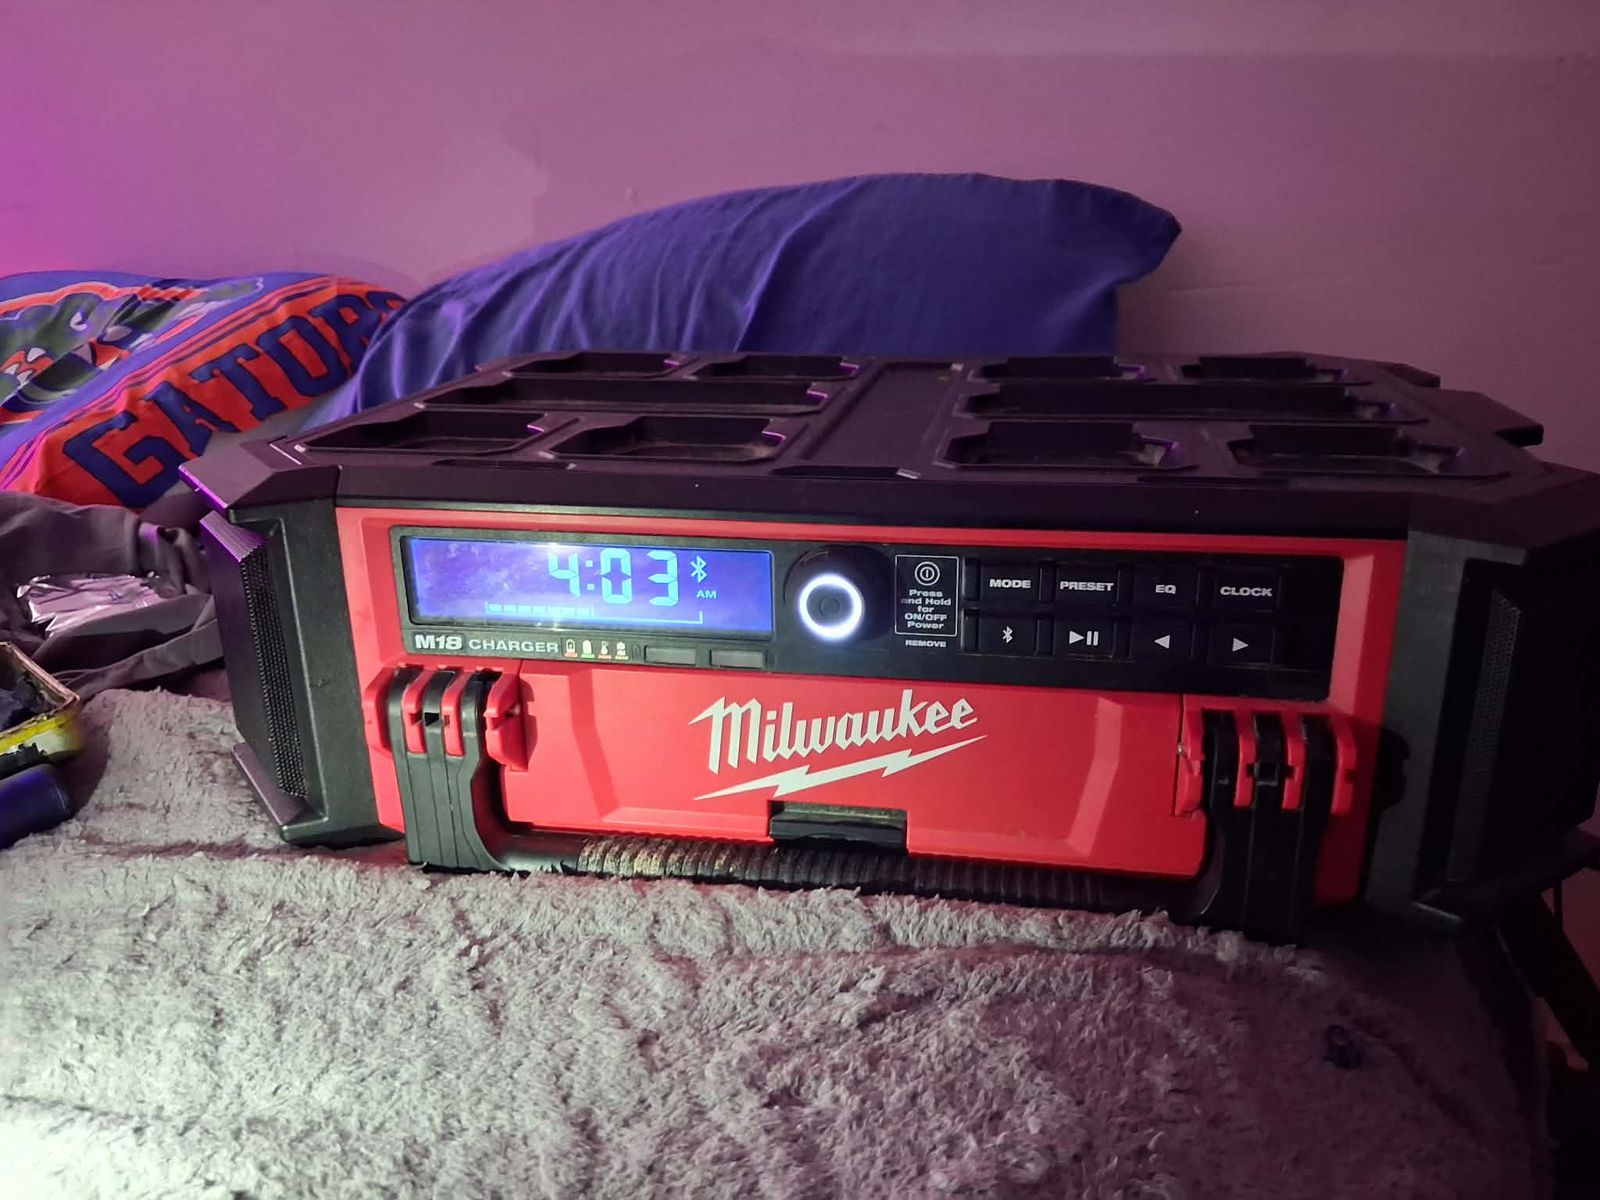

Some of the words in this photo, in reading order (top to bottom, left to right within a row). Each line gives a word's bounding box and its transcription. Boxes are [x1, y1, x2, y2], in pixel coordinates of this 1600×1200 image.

[548, 548, 679, 606] 4:03
[989, 579, 1031, 589] MODE
[1059, 581, 1114, 592] PRESET
[1155, 584, 1177, 595] EQ
[696, 589, 718, 600] AM
[909, 589, 943, 597] Press
[1220, 585, 1273, 598] CLOCK
[925, 597, 951, 605] Hold
[904, 613, 947, 621] ON/OFF
[907, 621, 944, 629] Power
[415, 634, 462, 651] M18
[468, 639, 559, 654] CHARGER
[905, 640, 946, 648] REMOVE
[688, 689, 978, 775] Milwaukee
